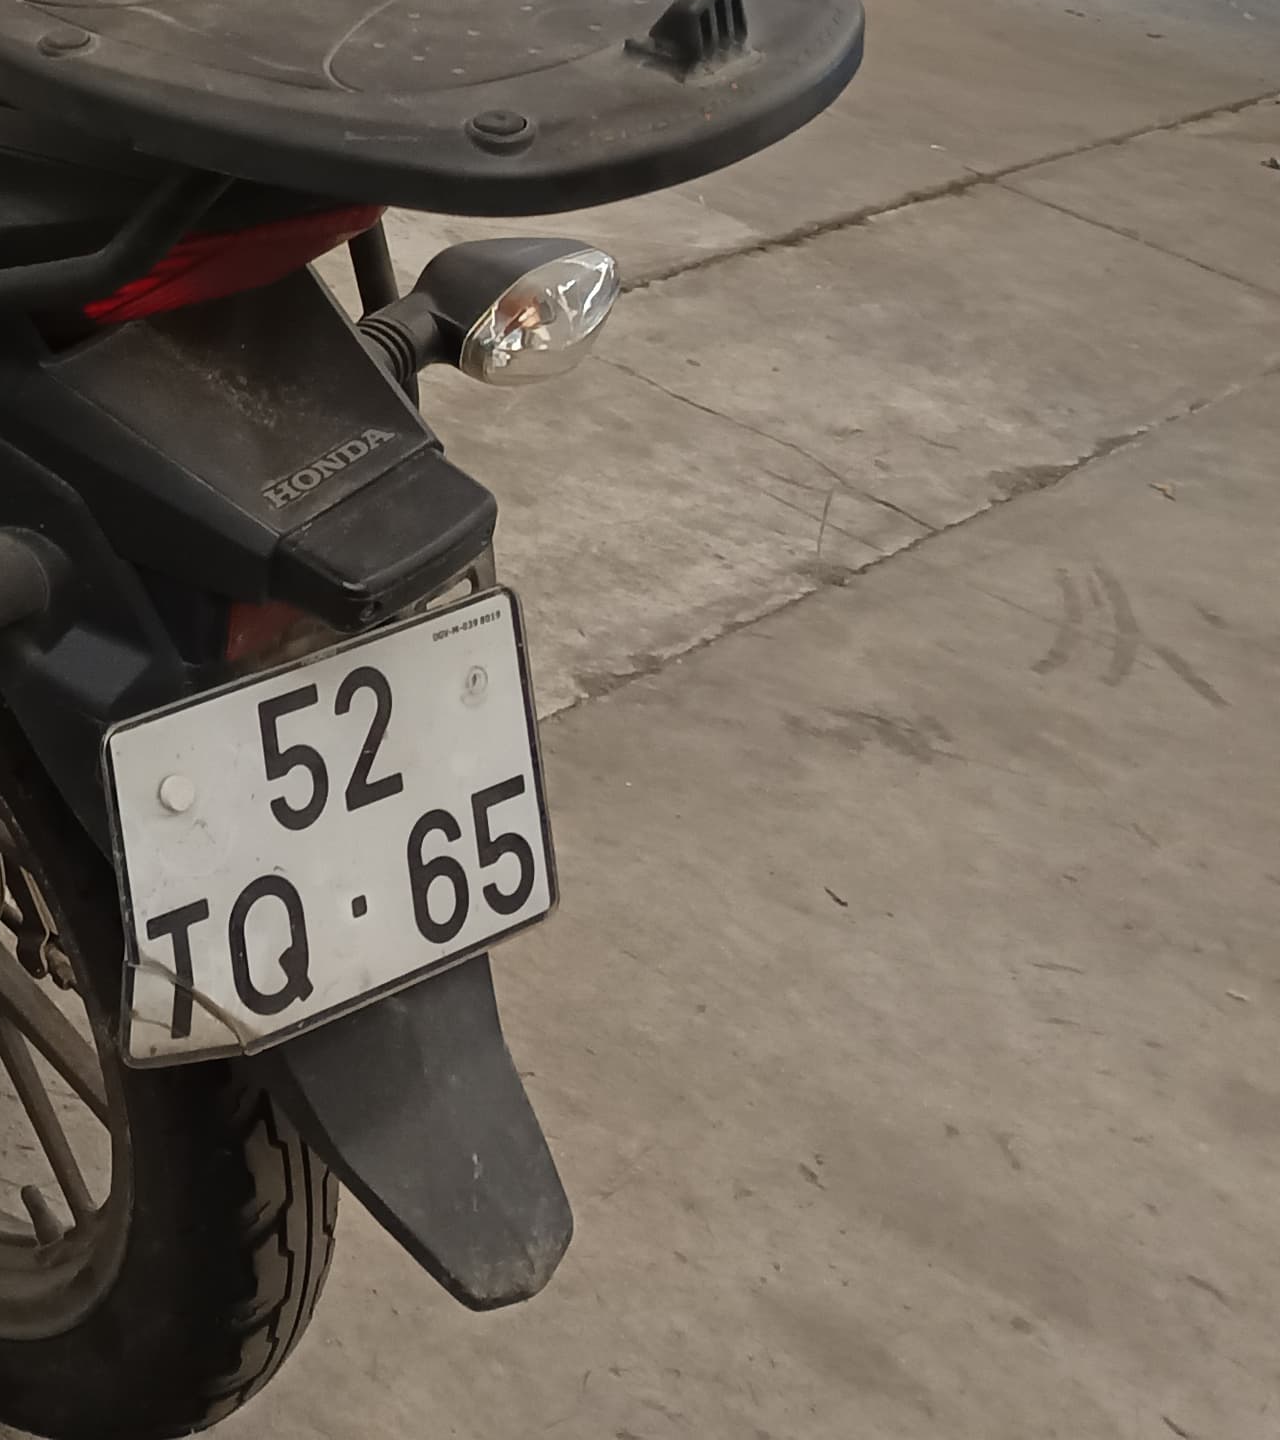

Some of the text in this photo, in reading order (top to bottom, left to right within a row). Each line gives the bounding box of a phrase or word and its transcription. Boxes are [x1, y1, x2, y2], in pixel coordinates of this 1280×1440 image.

[263, 428, 396, 509] HONDA
[257, 665, 404, 832] 52
[146, 874, 314, 1040] TQ
[406, 773, 536, 945] 65
